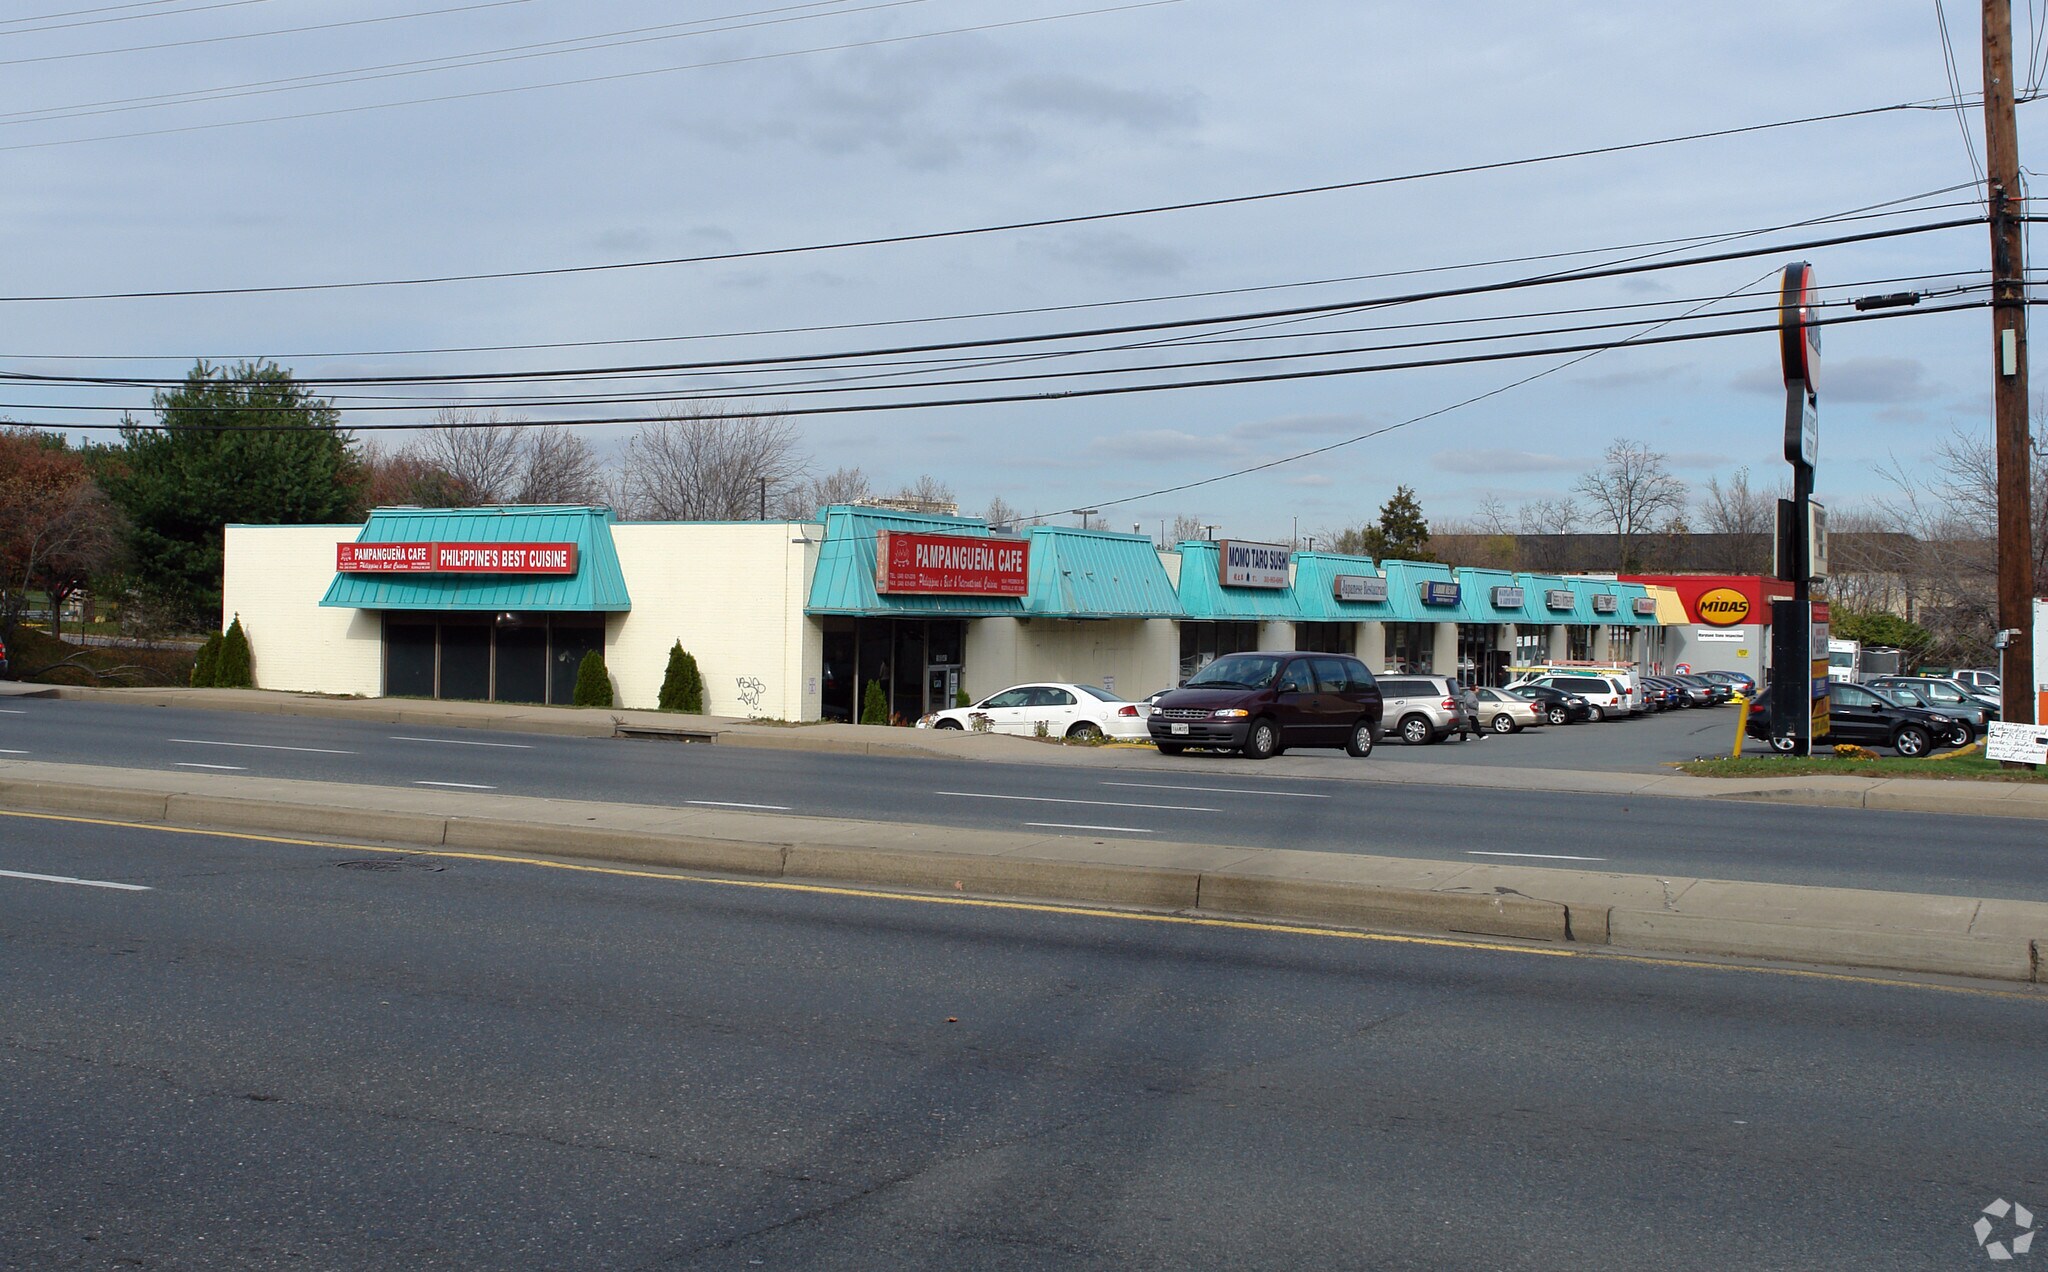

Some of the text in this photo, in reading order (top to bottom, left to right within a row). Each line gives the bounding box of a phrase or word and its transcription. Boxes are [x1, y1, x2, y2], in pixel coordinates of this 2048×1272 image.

[354, 545, 427, 561] PAMPANGUEÑA CAFE
[440, 549, 567, 568] PHILIPPINE'S BEST CUISINE
[916, 543, 1023, 573] PAMPANGUEÑA CAFE
[1228, 546, 1288, 571] MOMO TARO SUSHI
[1701, 601, 1747, 612] MIDAS
